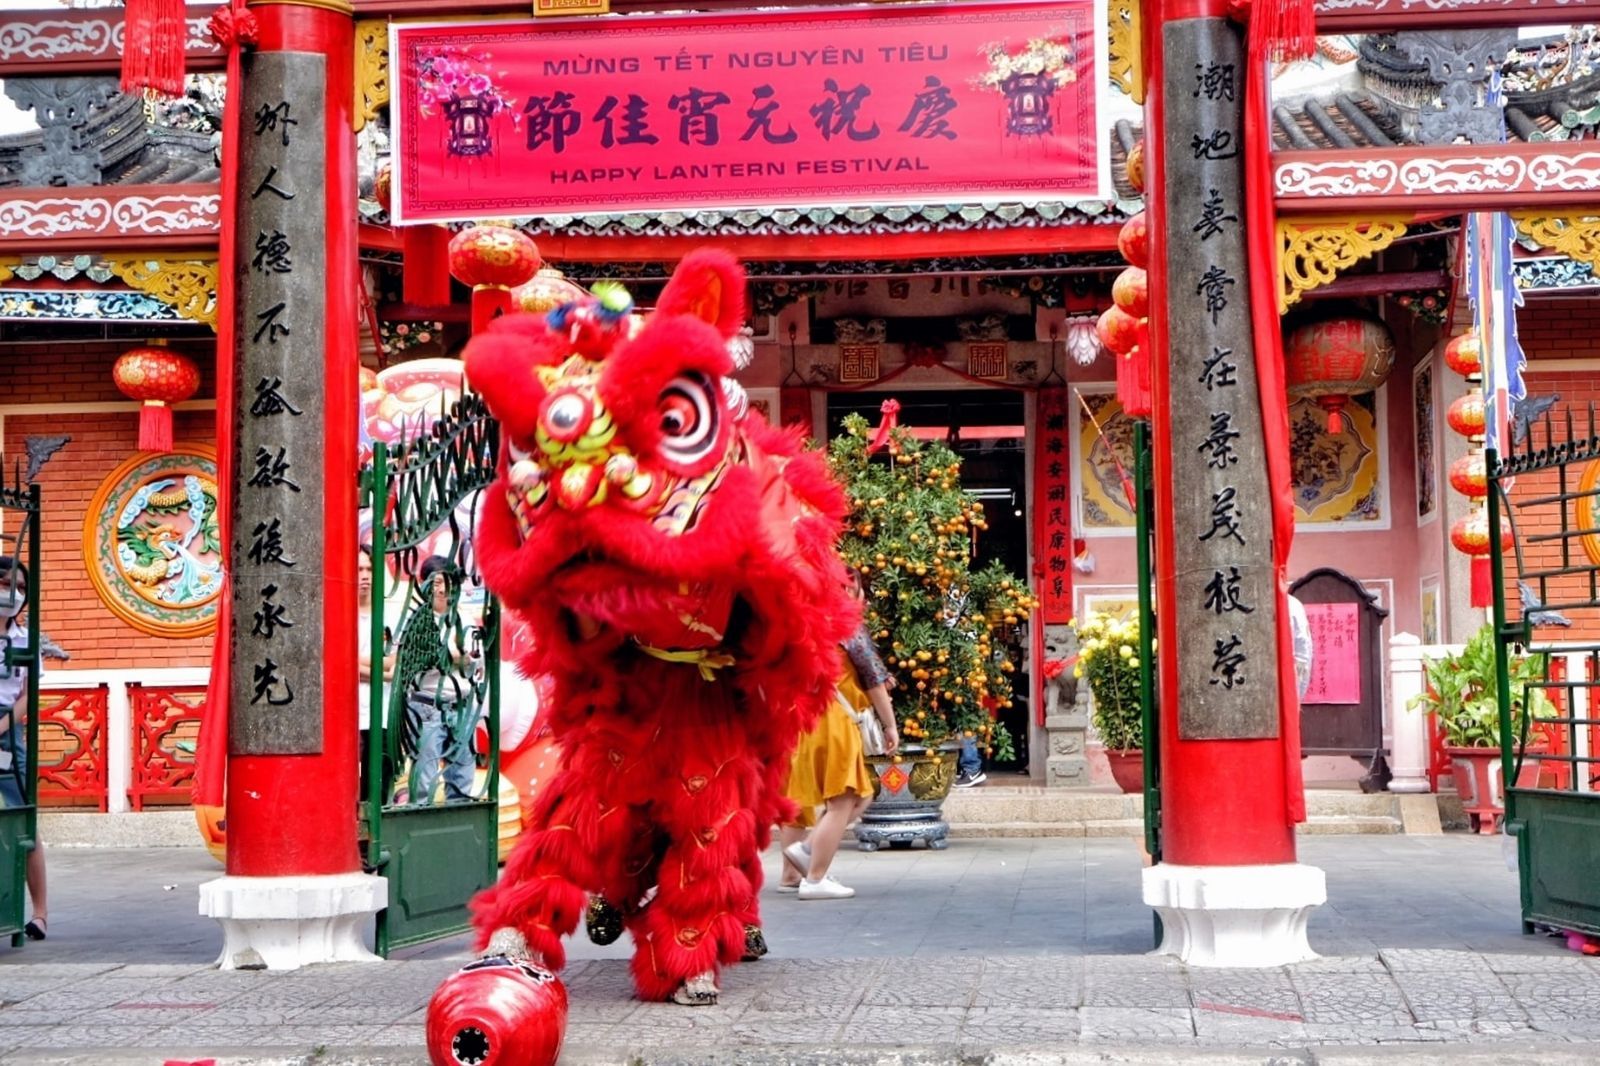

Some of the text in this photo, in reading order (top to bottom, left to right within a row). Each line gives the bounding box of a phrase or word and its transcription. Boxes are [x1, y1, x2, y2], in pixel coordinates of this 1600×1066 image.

[543, 42, 949, 76] MỪNG TẾT NGUYÊN TIÊU
[550, 157, 929, 184] HAPPY LANTERN FESTIVAL
